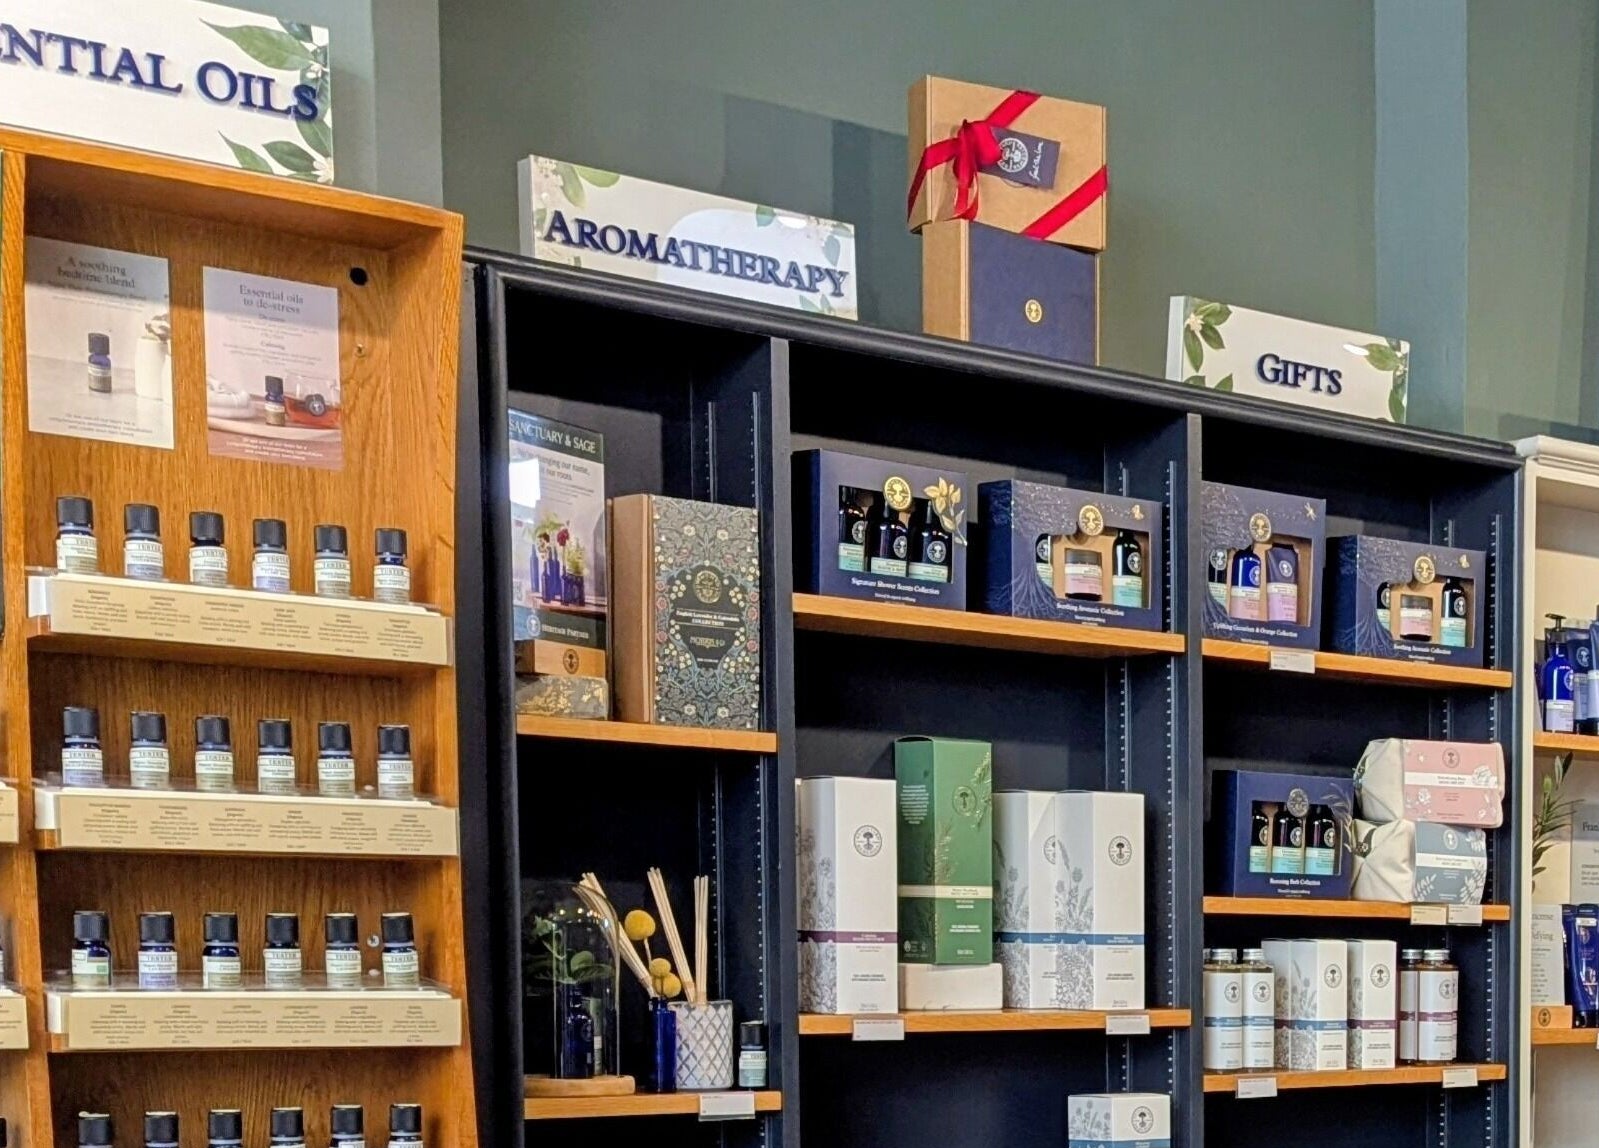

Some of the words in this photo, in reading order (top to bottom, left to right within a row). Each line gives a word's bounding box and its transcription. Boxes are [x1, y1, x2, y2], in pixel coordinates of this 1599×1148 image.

[0, 23, 183, 93] NTIAL
[197, 61, 318, 121] OILS
[545, 210, 850, 299] AROMATHERAPY
[68, 257, 75, 266] A
[79, 259, 126, 276] soothing
[105, 273, 135, 289] blend
[240, 284, 283, 302] Essential
[287, 292, 303, 304] oils
[244, 298, 254, 306] to
[257, 299, 300, 314] de-stress
[1256, 352, 1343, 396] GIFTS
[509, 420, 564, 444] SANCTUARY
[565, 434, 571, 447] &
[574, 437, 596, 453] SAGE
[69, 751, 96, 759] TESTER
